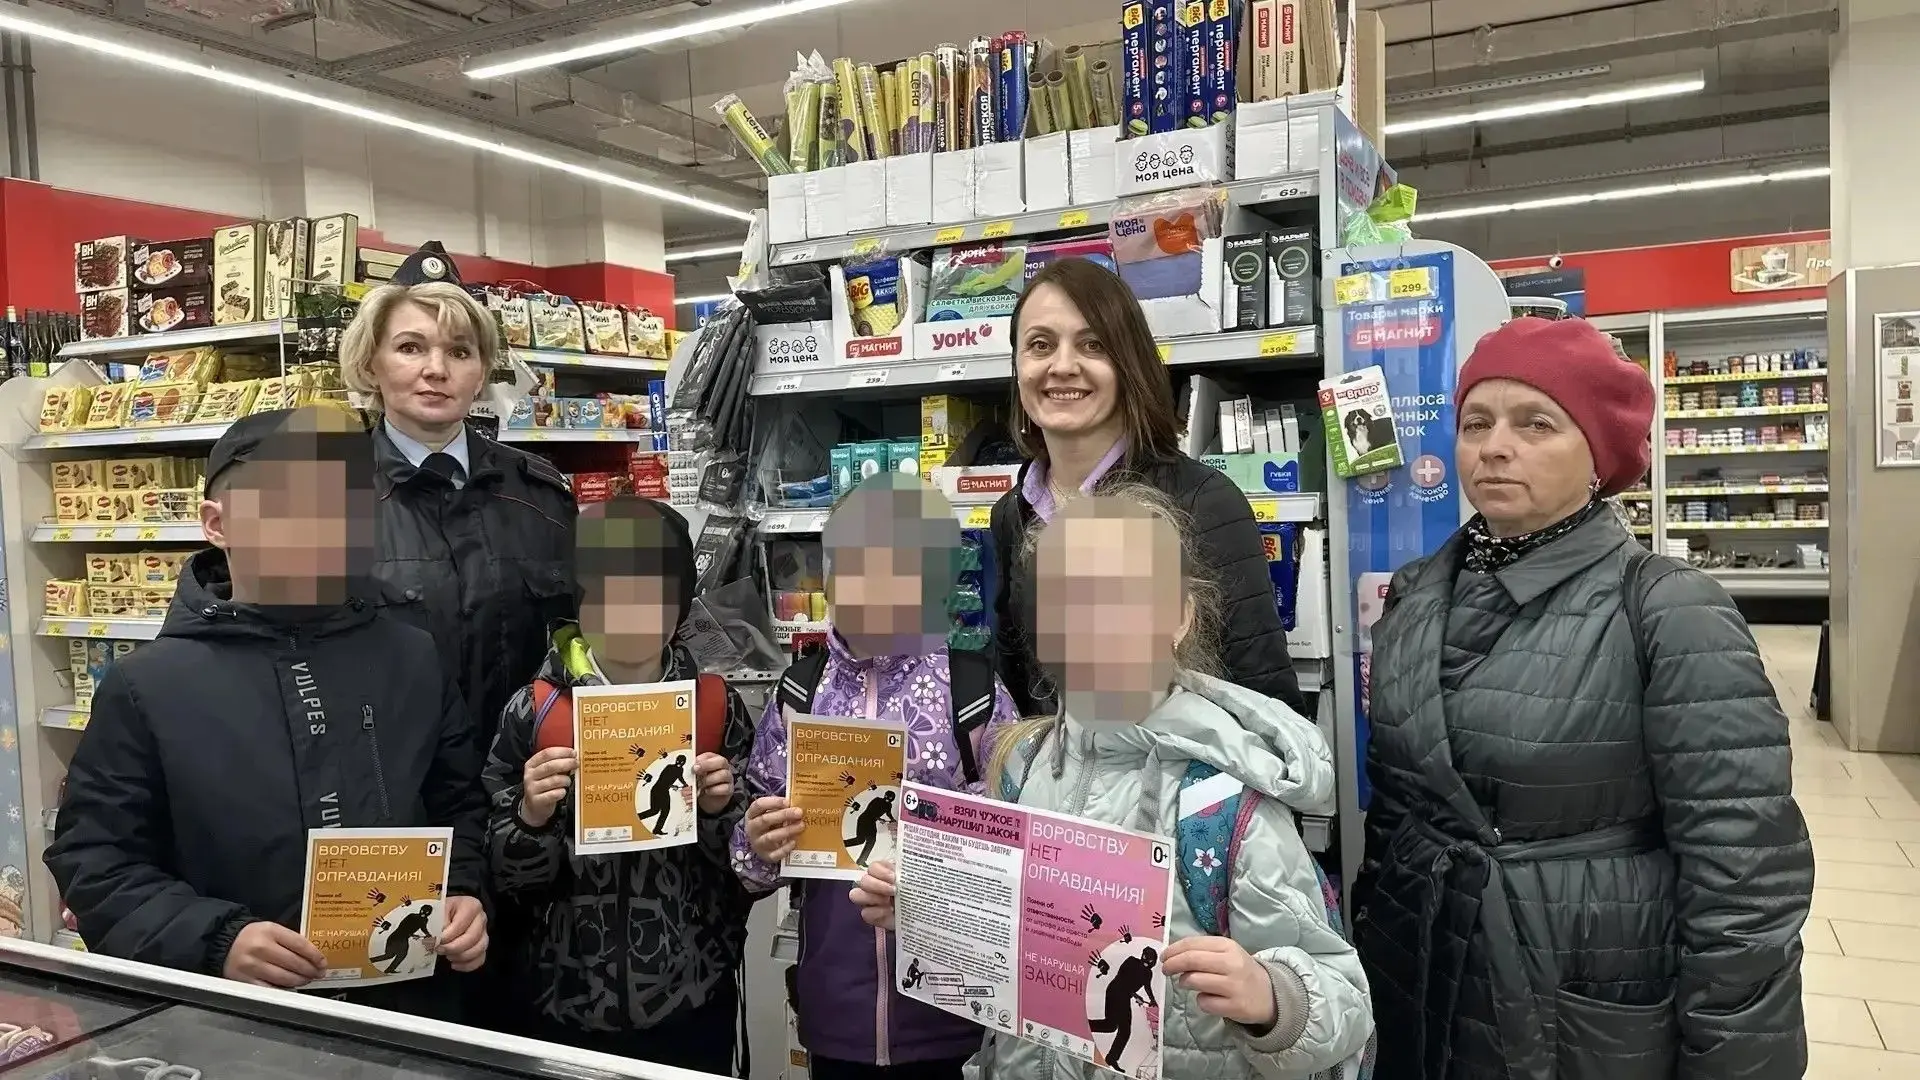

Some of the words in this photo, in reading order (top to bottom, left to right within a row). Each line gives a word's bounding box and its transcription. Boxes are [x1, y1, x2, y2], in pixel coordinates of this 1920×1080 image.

[1129, 31, 1141, 98] пергамент
[1190, 29, 1201, 96] пергамент
[1214, 23, 1225, 91] пергамент
[1135, 170, 1159, 183] моя
[1162, 164, 1195, 180] цена
[1279, 188, 1298, 197] 69
[1401, 283, 1422, 293] 299
[931, 298, 969, 307] САЛФЕТКА
[972, 293, 1017, 304] ВИСКОЗНАЯ
[969, 304, 983, 313] ДЛЯ
[984, 303, 1016, 312] УБОРКИ
[1348, 308, 1398, 322] Товары
[1401, 304, 1445, 318] марки
[932, 328, 978, 351] york
[1374, 326, 1433, 342] МАГНИТ
[861, 342, 898, 353] МАГНИТ
[769, 354, 790, 364] моя
[792, 352, 819, 363] цена
[971, 479, 1009, 489] МАГНИТ
[291, 661, 326, 736] VULPES
[583, 700, 660, 714] ВОРОВСТВУ
[583, 715, 609, 727] НЕТ
[583, 723, 674, 740] ОПРАВДАНИЯ!
[796, 728, 871, 744] ВОРОВСТВУ
[795, 752, 885, 769] ОПРАВДАНИЯ!
[585, 784, 596, 792] НЕ
[597, 782, 634, 791] НАРУШАЙ
[585, 791, 633, 804] ЗАКОН!
[905, 794, 917, 805] 6+
[806, 807, 842, 816] НАРУШАЙ
[953, 805, 977, 819] ВЗЯЛ
[979, 811, 1013, 827] ЧУЖОЕ
[802, 817, 840, 827] АКОН!
[986, 824, 1020, 842] ЗАКОН!
[1032, 822, 1130, 856] ВОРОВСТВУ
[941, 833, 960, 844] КАКИМ
[960, 837, 968, 846] ТЫ
[968, 839, 990, 852] БУДЕШЬ
[319, 845, 409, 857] ВОРОВСТВУ
[1030, 842, 1062, 863] НЕТ
[317, 857, 348, 870] НЕТ
[316, 870, 422, 883] ОПРАВДАНИЯ!
[1028, 863, 1145, 905] ОПРАВДАНИЯ!
[327, 929, 369, 937] НАРУШАЙ
[311, 939, 367, 950] ЗАКОН!
[1025, 951, 1038, 962] НЕ
[1040, 955, 1086, 976] НАРУШАЙ
[1025, 964, 1083, 996] ЗАКОН!
